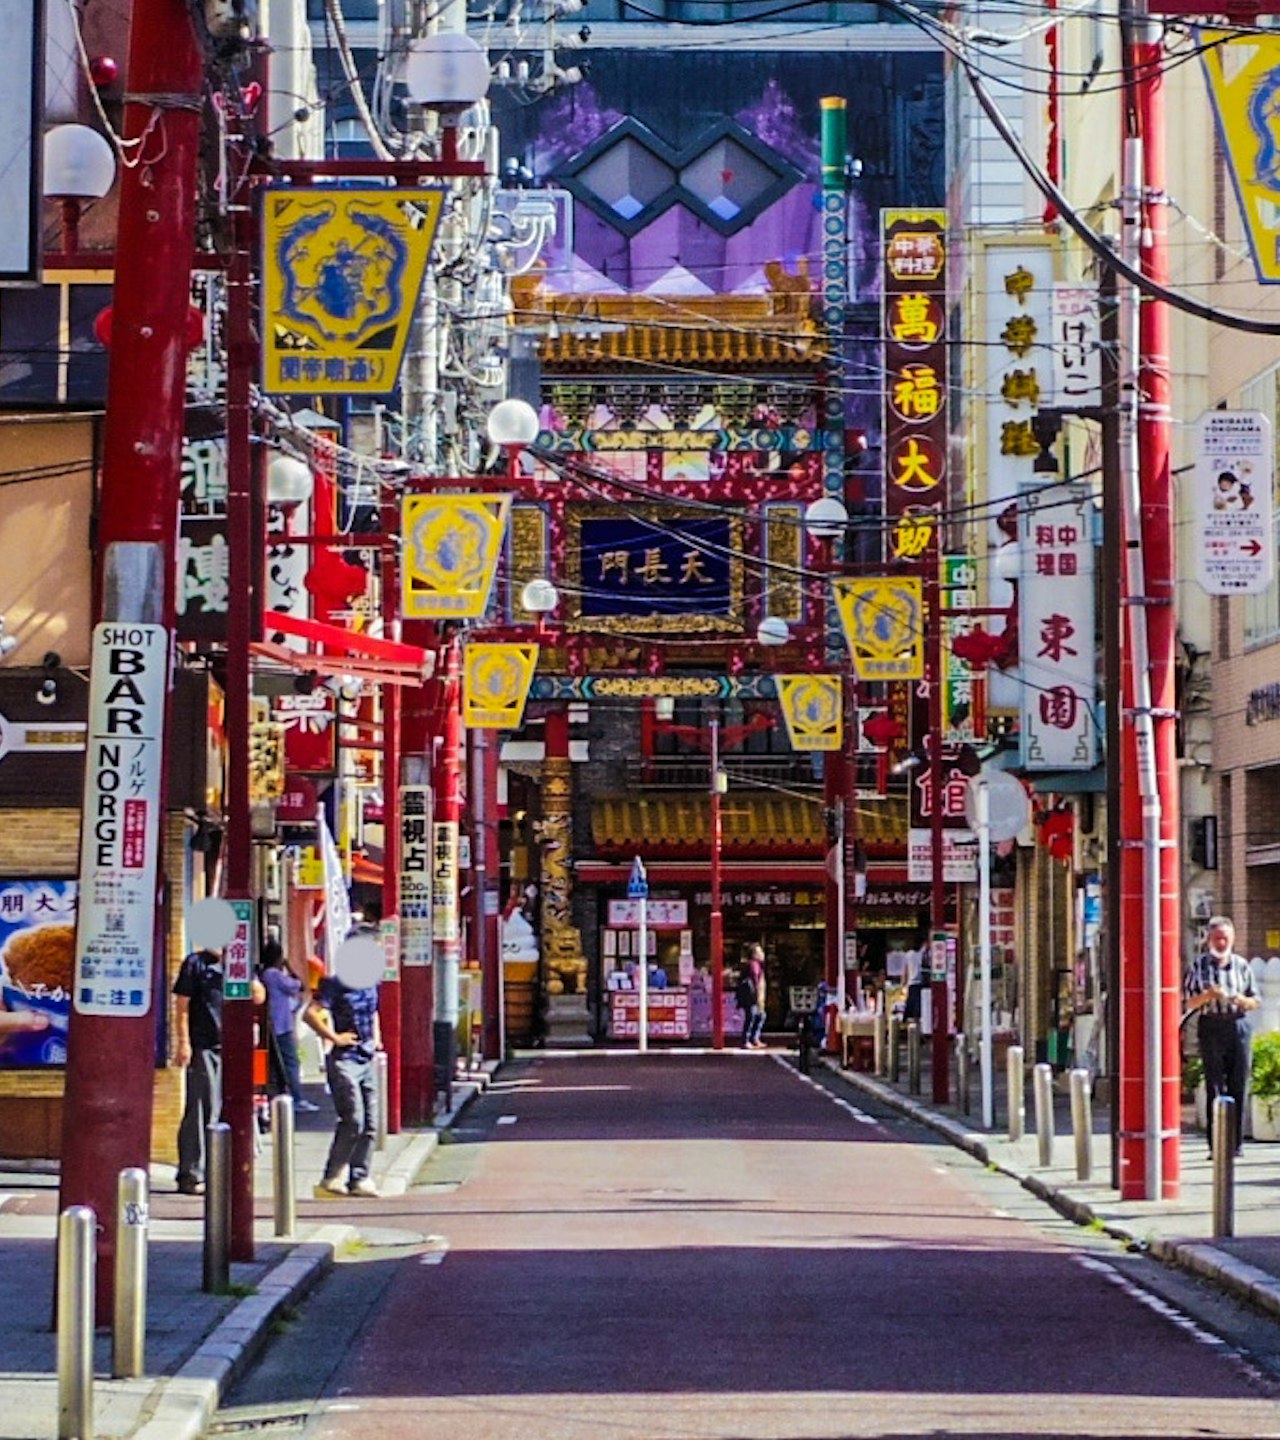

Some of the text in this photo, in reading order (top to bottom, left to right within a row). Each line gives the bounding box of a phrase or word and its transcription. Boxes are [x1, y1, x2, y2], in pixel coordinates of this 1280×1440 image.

[1062, 320, 1089, 396] けいこ
[102, 627, 156, 648] SHOT
[1037, 613, 1080, 731] 東園
[104, 648, 146, 736] BAR
[94, 744, 121, 869] NORGE
